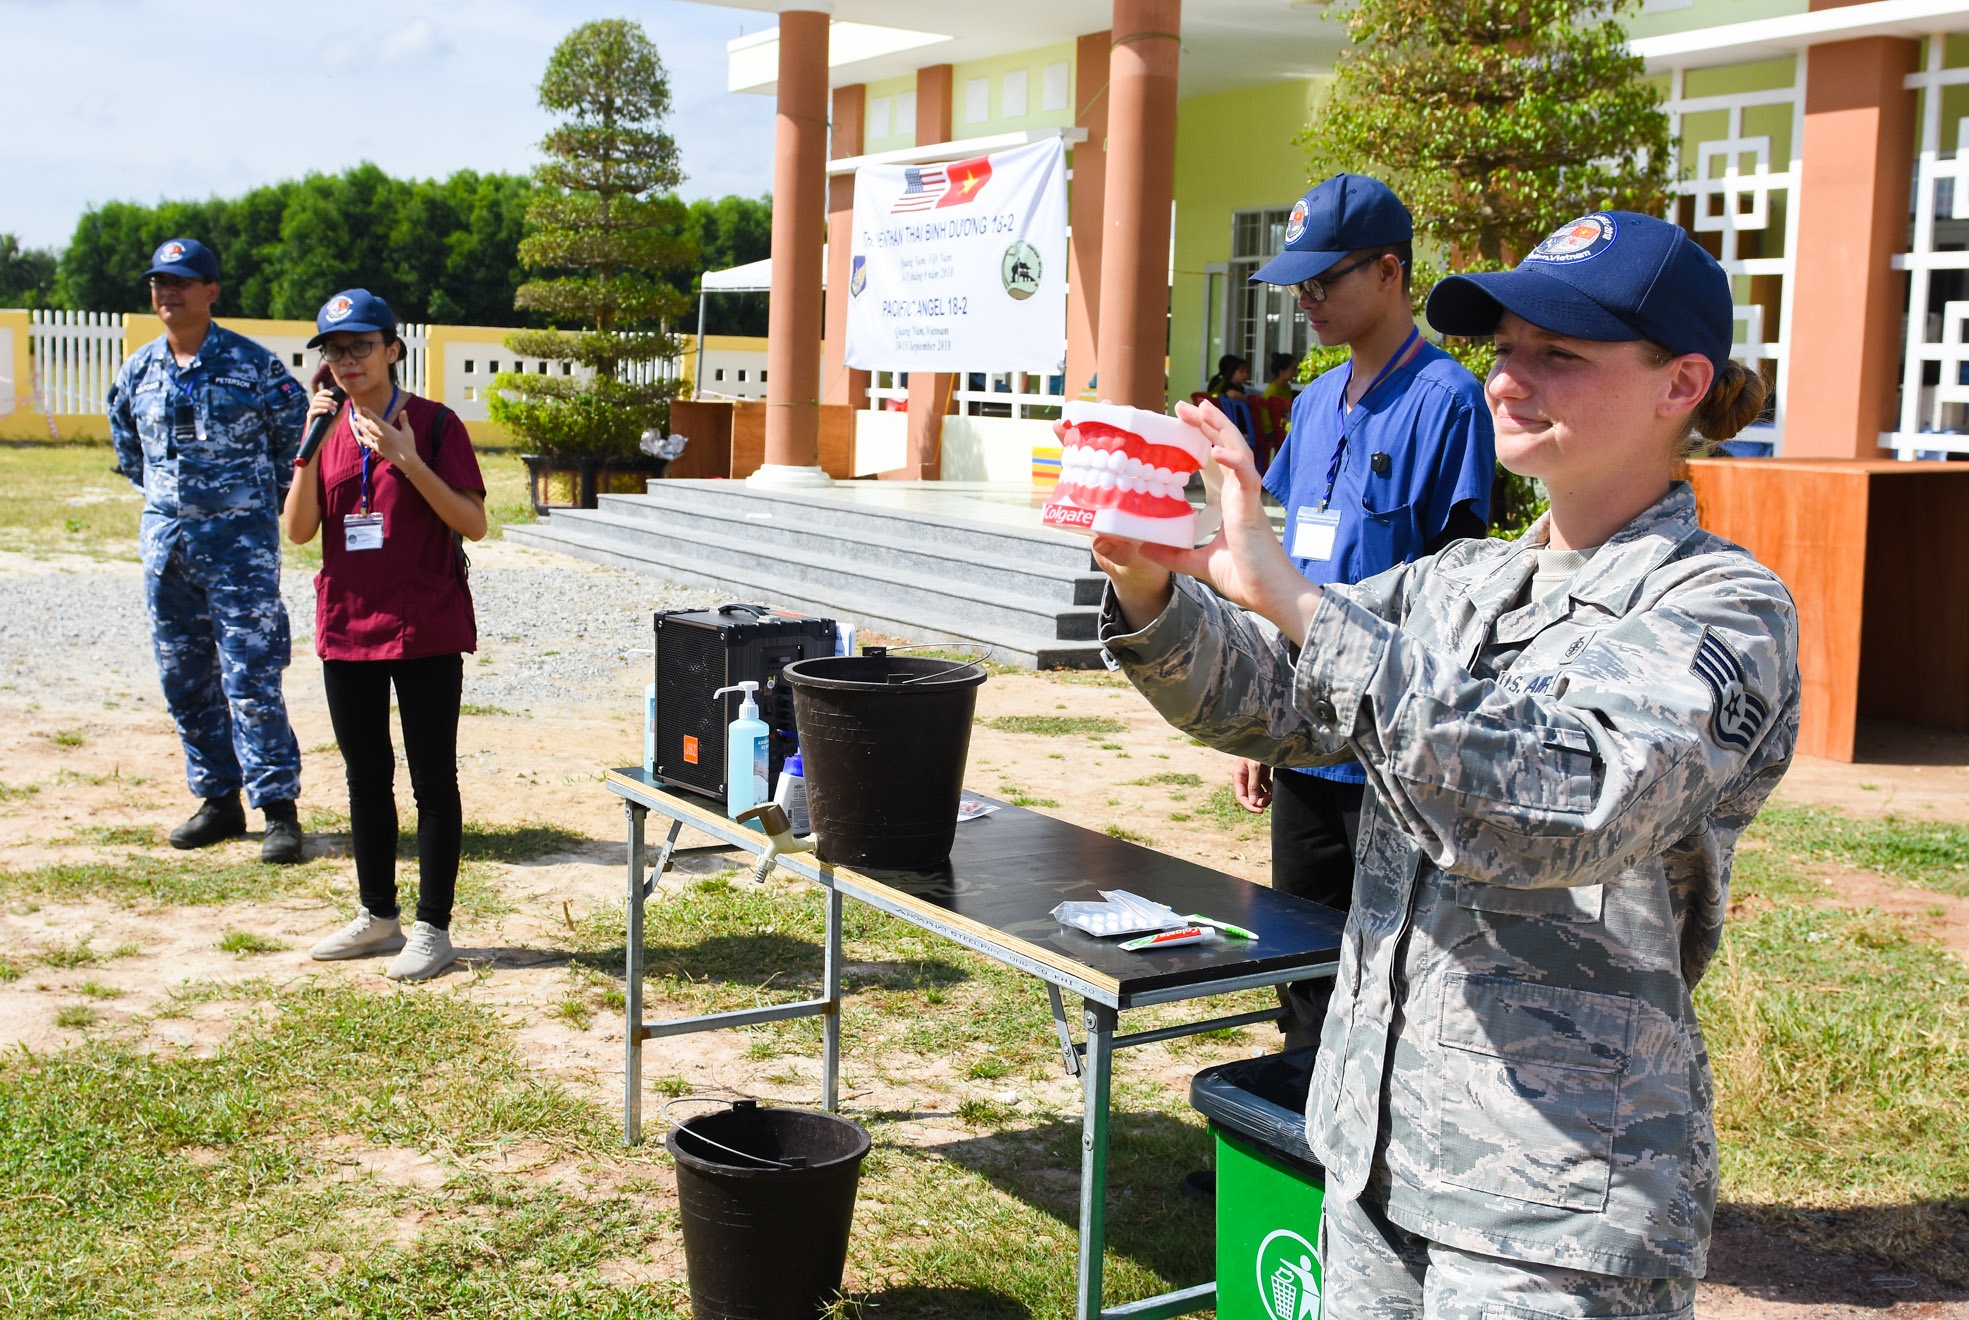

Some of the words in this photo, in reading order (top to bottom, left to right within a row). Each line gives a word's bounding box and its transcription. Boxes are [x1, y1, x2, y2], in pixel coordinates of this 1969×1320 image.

[882, 299, 915, 318] PACIFIC
[915, 297, 944, 317] ANGEL
[948, 296, 968, 315] 18-2
[215, 377, 250, 388] PETERSON
[1044, 505, 1093, 524] Colgate
[1159, 926, 1200, 938] Colgate
[1054, 974, 1073, 986] KHI
